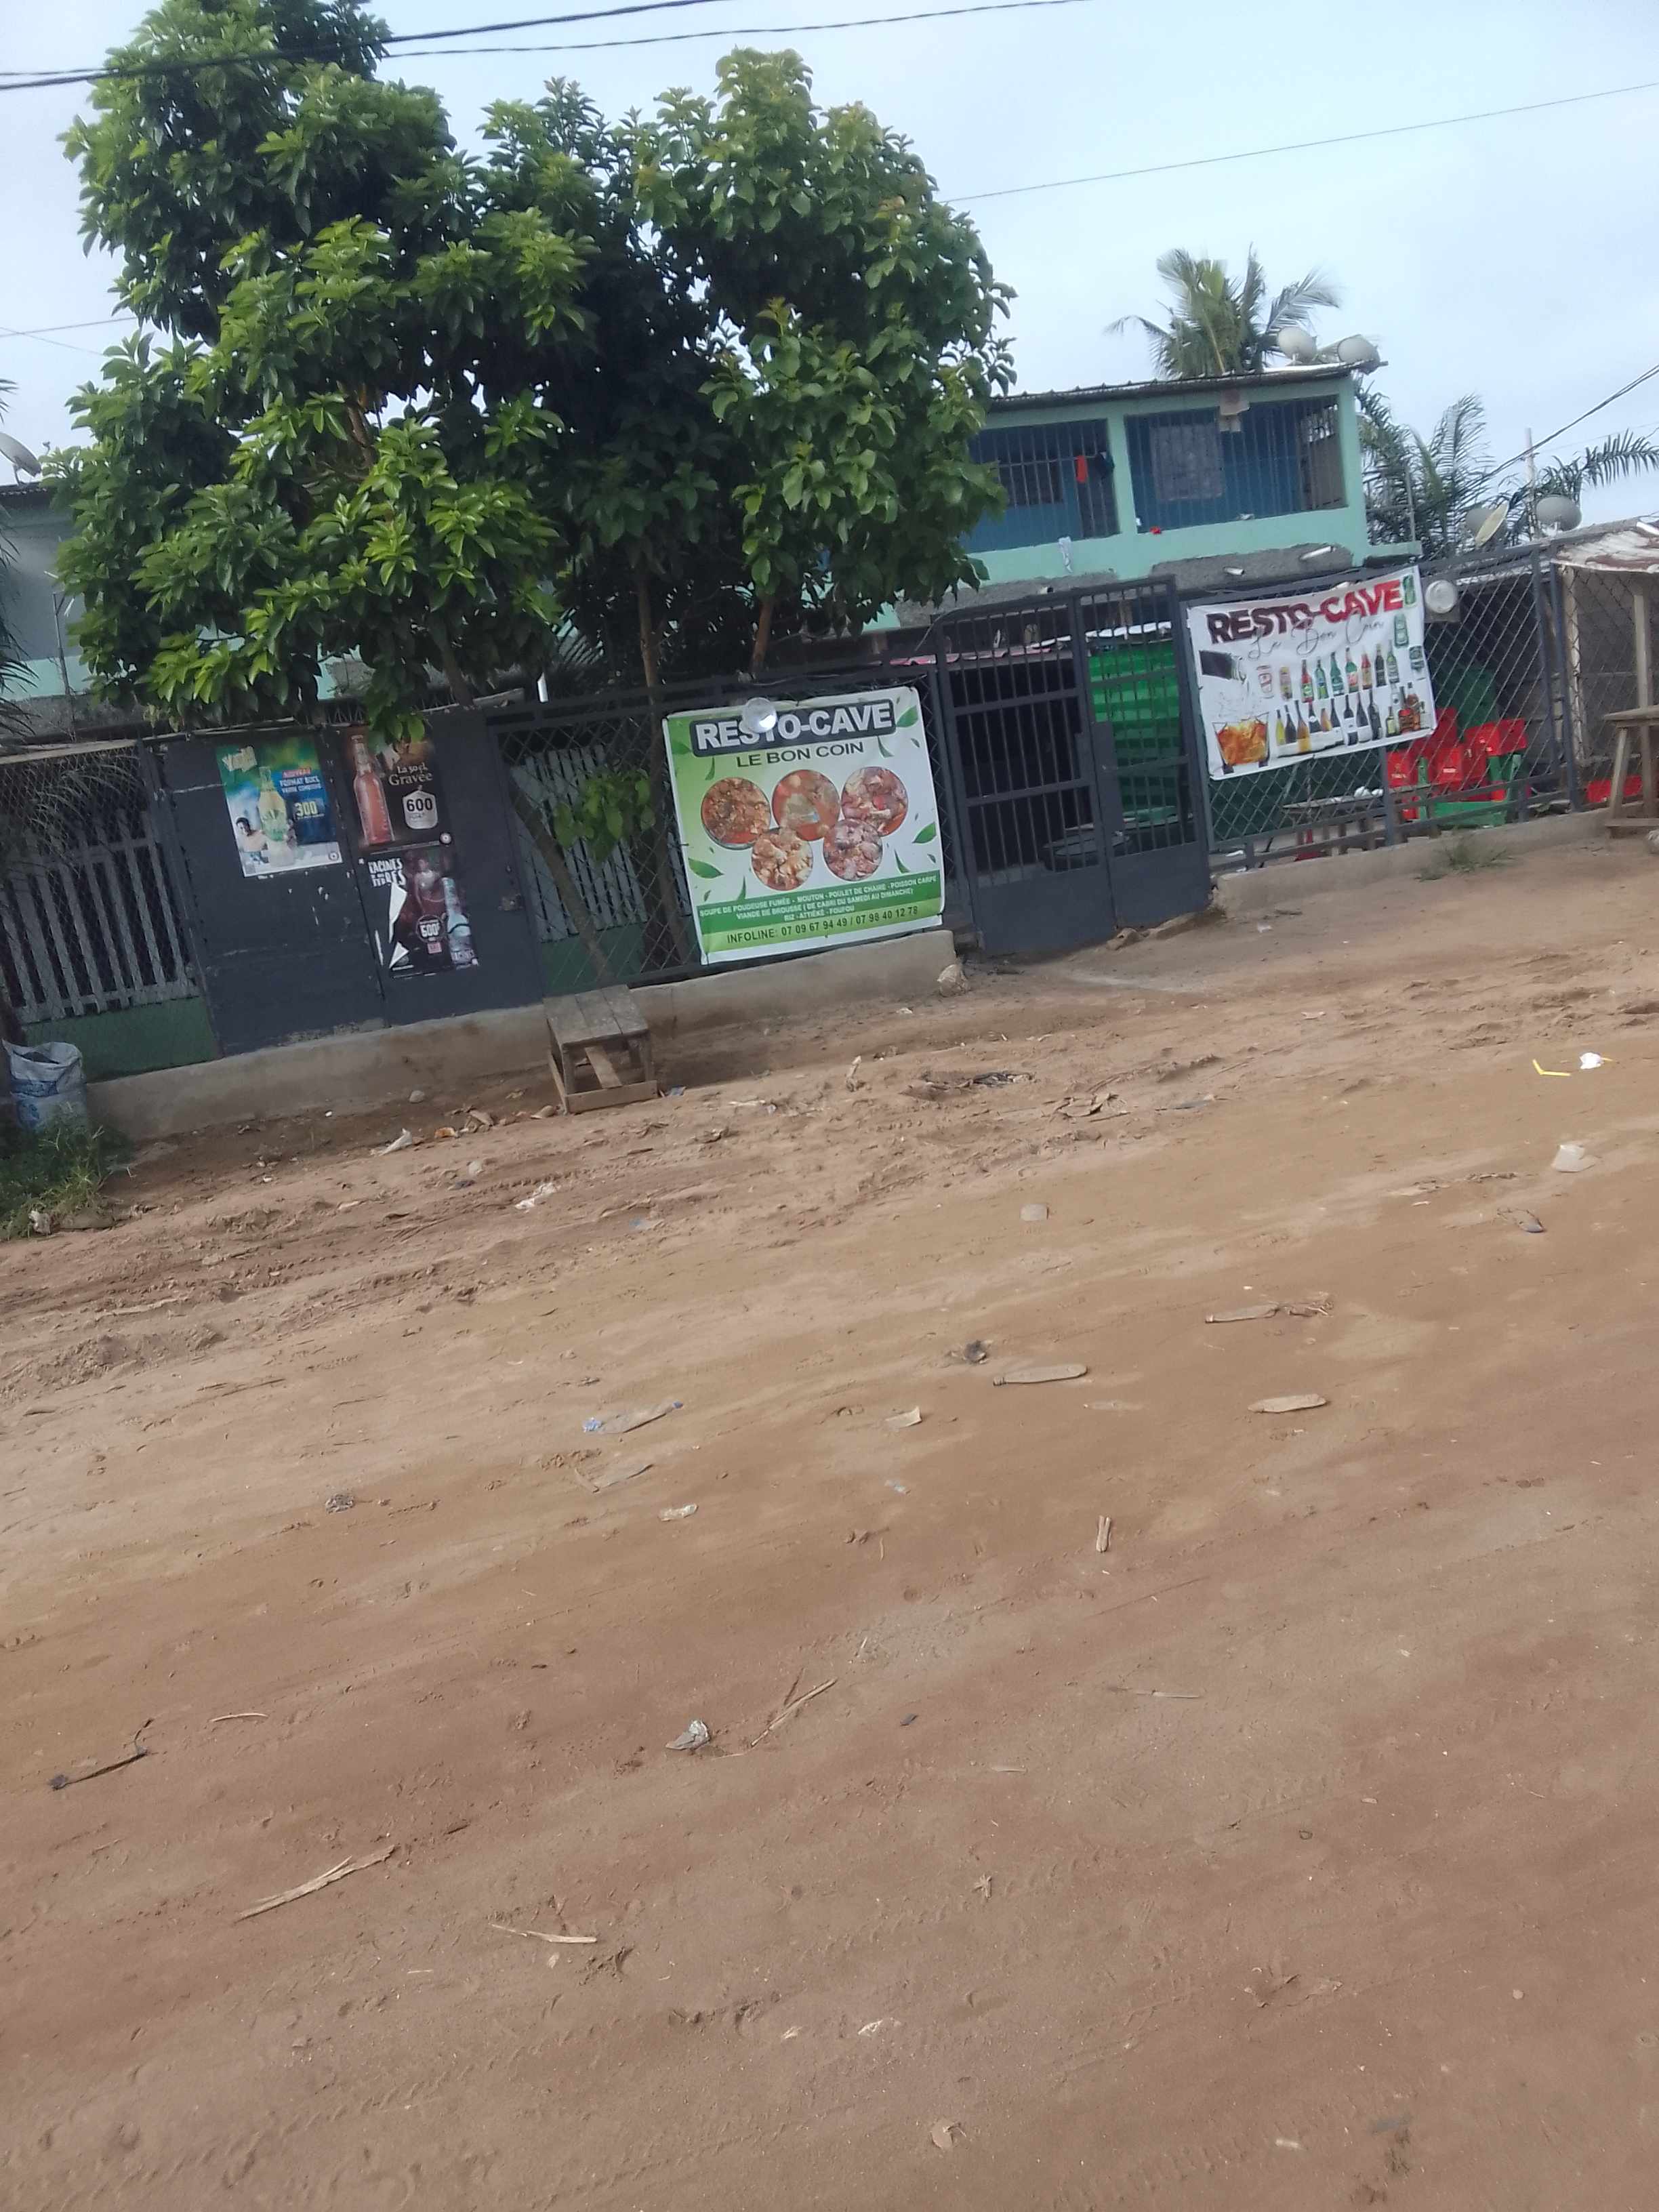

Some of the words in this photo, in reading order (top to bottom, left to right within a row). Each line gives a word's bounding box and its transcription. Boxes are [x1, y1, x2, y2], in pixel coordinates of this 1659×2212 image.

[1206, 580, 1403, 644] RESTO-CAVE
[737, 754, 762, 767] LE
[766, 747, 811, 764] BON
[815, 741, 864, 758] COIN
[294, 801, 318, 817] 300
[407, 798, 433, 812] 600
[699, 907, 722, 918] SOUPE
[797, 893, 824, 903] MOUTON
[829, 889, 853, 898] POULET
[891, 879, 917, 888] POISSON
[918, 875, 937, 884] CARPE
[736, 912, 760, 920] VIANDE
[772, 905, 802, 916] BROUSSE
[847, 895, 870, 904] SAMEDI
[781, 926, 792, 936] 07
[796, 924, 806, 934] 09
[823, 920, 834, 929] 94
[836, 918, 847, 927] 49
[856, 915, 866, 924] 07
[882, 910, 893, 920] 40
[895, 908, 905, 918] 12
[830, 905, 855, 914] FOUFOU
